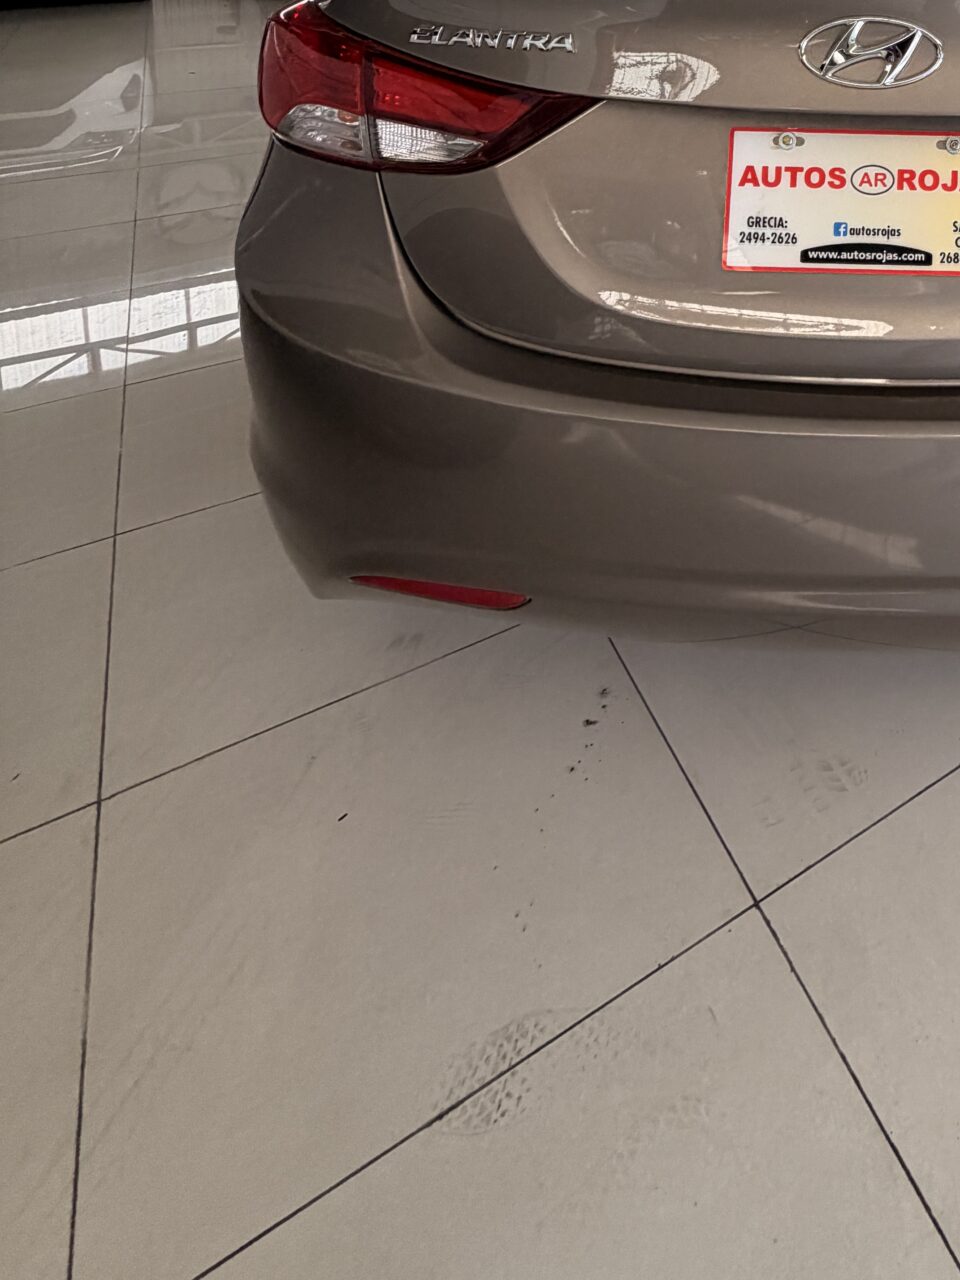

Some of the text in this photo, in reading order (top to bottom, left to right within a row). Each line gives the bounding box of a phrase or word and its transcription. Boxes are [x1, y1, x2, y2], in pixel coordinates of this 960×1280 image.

[409, 24, 577, 53] ELANTRA
[738, 165, 846, 190] AUTOS
[858, 171, 887, 188] AR
[746, 216, 788, 229] GRECIA:
[739, 231, 798, 245] 2494-2626
[849, 225, 901, 240] autosrojas
[808, 250, 925, 263] www.autosrojas.com
